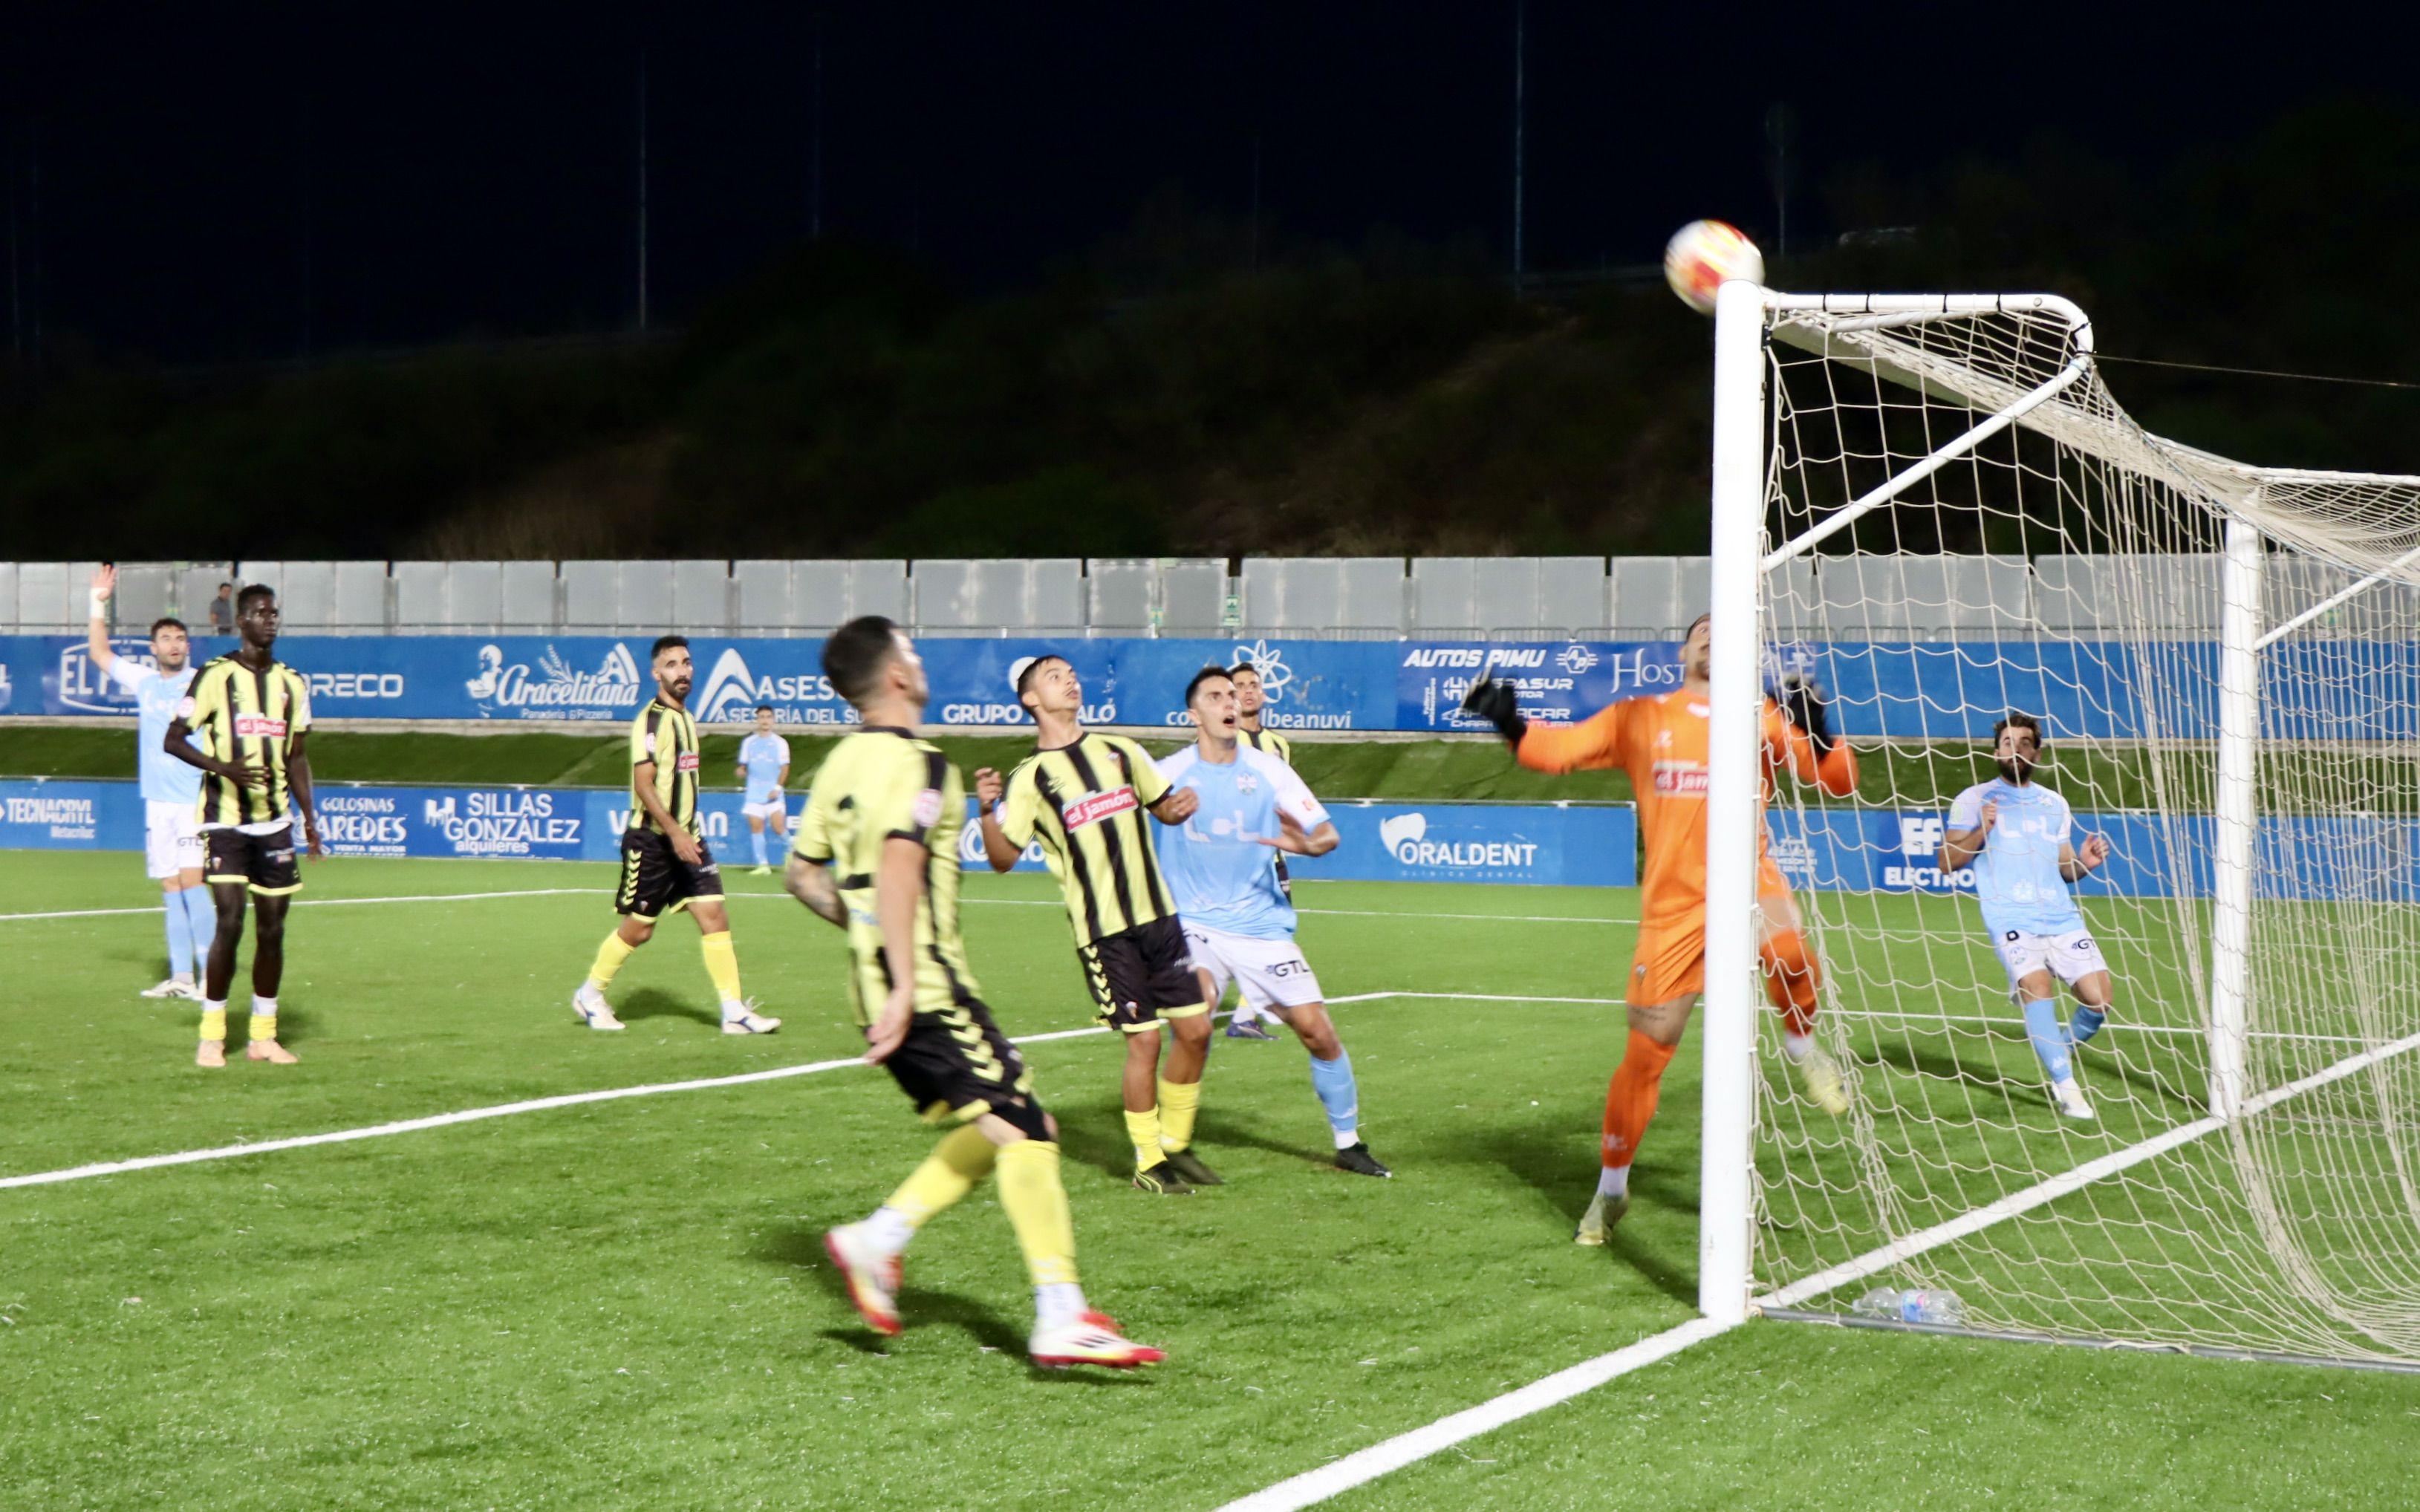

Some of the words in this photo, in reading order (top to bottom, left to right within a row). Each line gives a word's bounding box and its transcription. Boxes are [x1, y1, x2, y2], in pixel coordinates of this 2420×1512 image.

[1403, 649, 1484, 668] AUTOS
[1486, 649, 1546, 668] PIMU
[755, 675, 847, 701] ASES
[716, 706, 804, 724] ASESRÍA
[807, 708, 837, 724] DEL
[844, 708, 866, 725] SU
[943, 703, 1024, 724] GRUPO
[6, 798, 96, 824] TECNACRYL
[320, 798, 395, 812] GOLOSINAS
[466, 792, 553, 817] SILLAS
[1067, 806, 1084, 824] el
[1082, 789, 1132, 821] jamón
[445, 813, 582, 844] GONZÁLEZ
[455, 838, 530, 856] alquileres
[1399, 841, 1538, 867] ORALDENT
[1274, 960, 1311, 977] GTL
